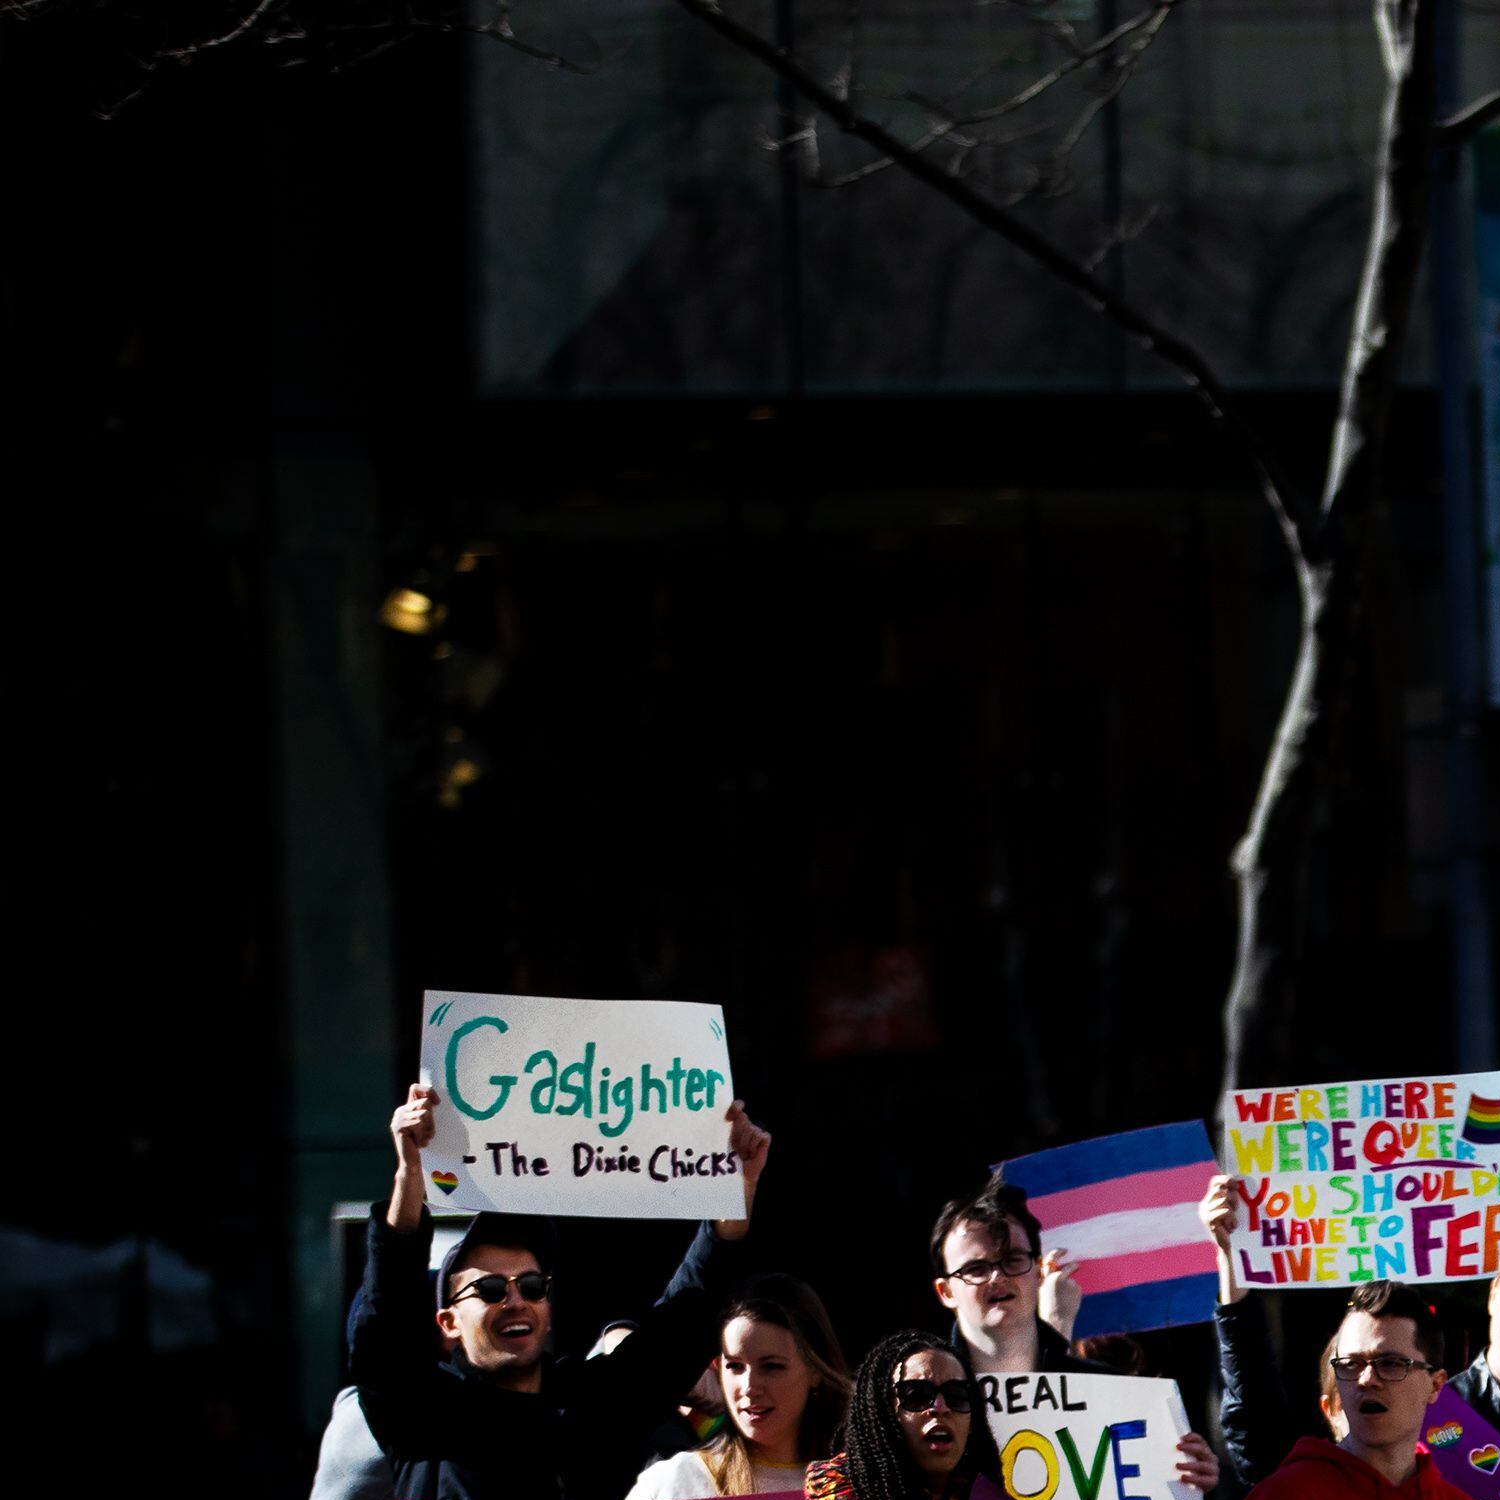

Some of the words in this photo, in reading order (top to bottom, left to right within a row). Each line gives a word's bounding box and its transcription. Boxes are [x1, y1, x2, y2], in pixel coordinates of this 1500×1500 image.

[1361, 1082, 1456, 1119] HERE
[486, 1142, 549, 1178] The
[573, 1142, 641, 1176] Dixie
[649, 1144, 737, 1182] Chicks
[1364, 1121, 1476, 1164] QUEER
[1237, 1177, 1316, 1231] YOU
[1262, 1218, 1345, 1246] HAVE
[1351, 1214, 1403, 1243] TO
[1240, 1247, 1338, 1284] LIVE
[1348, 1242, 1407, 1282] IN
